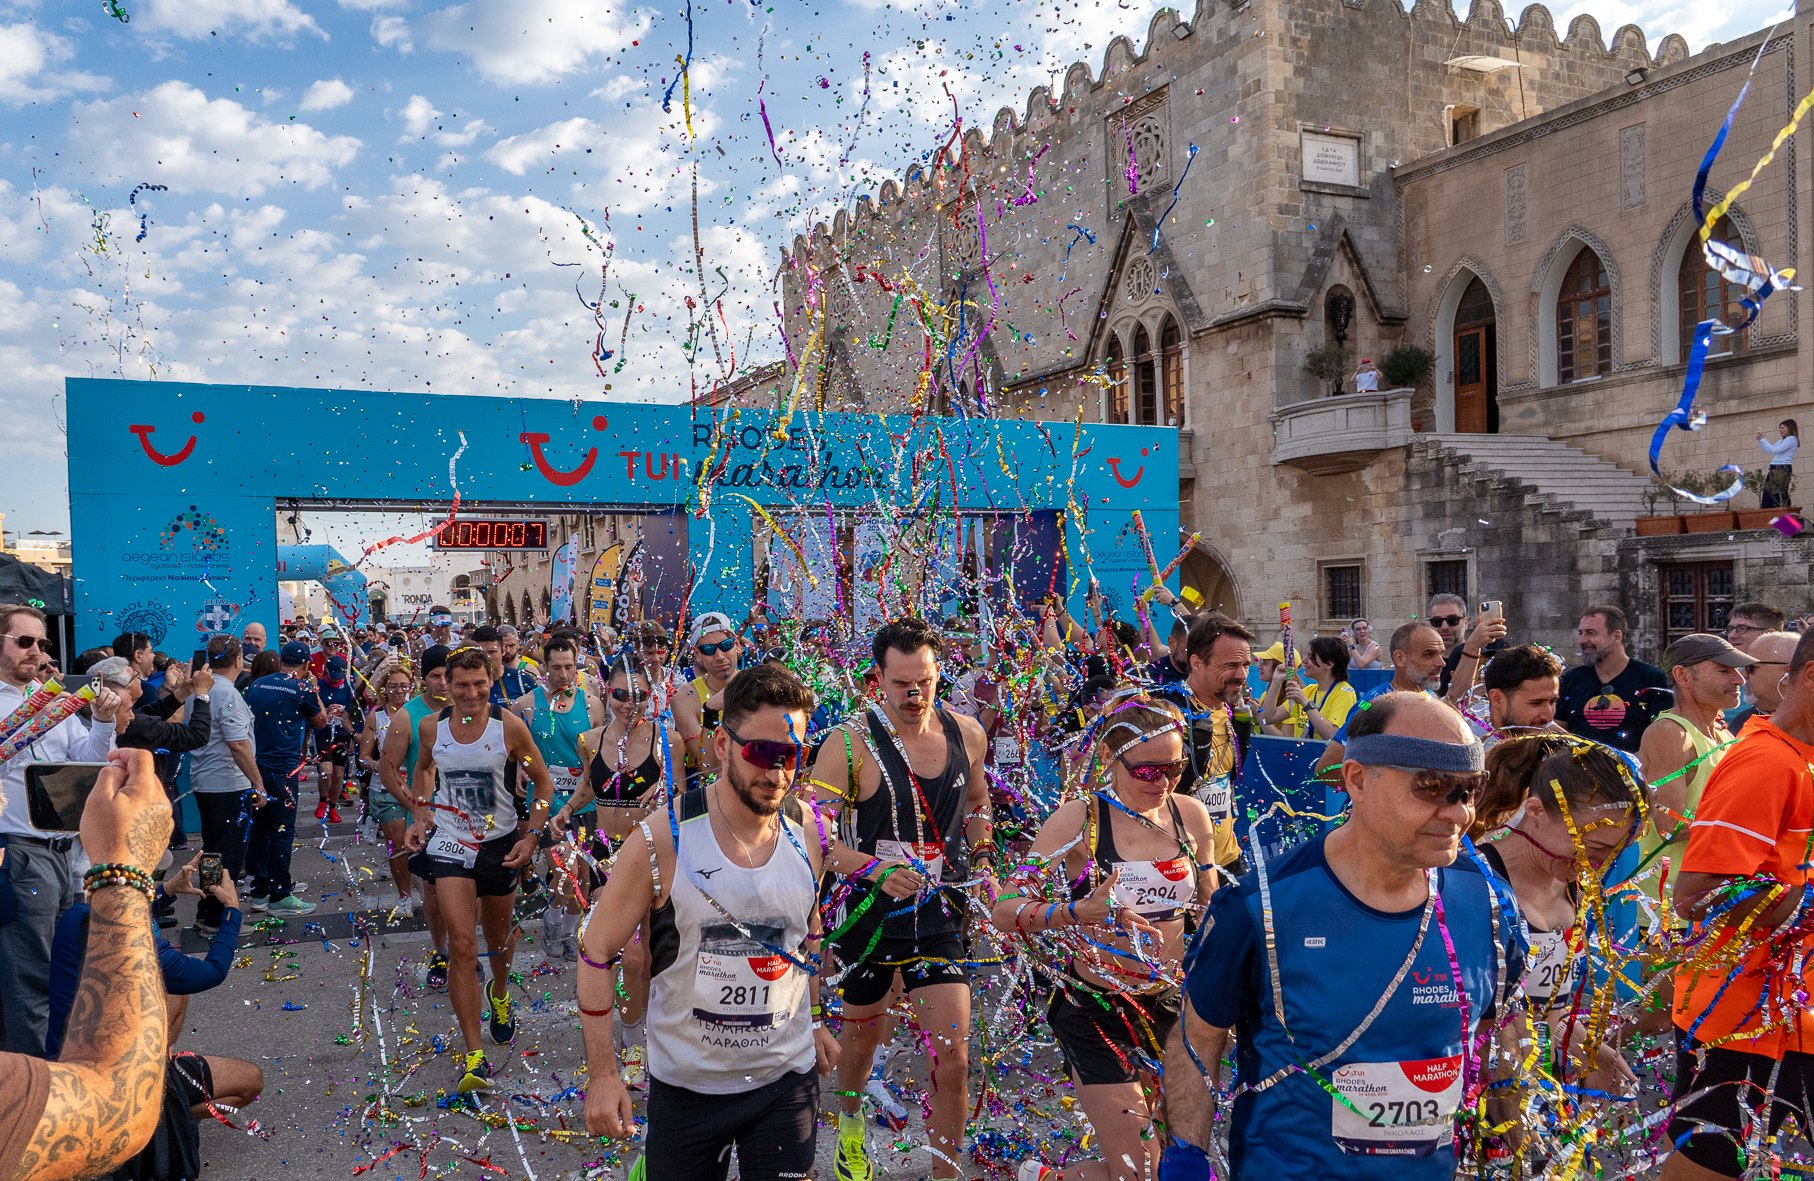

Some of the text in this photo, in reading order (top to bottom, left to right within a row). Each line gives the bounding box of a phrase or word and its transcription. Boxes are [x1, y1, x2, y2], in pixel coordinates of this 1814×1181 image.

[619, 451, 679, 481] TUI
[439, 522, 543, 547] 00:00:07
[121, 552, 178, 565] aegean
[403, 594, 433, 605] RONDA
[114, 600, 177, 629] ΔΗΜΟΣ ΡΟΔΟΥ
[556, 777, 577, 786] 2794
[1205, 792, 1227, 807] 4007
[438, 841, 465, 855] 2806
[1118, 875, 1148, 883] arathon
[756, 962, 789, 973] MARATHON
[767, 959, 782, 967] HALF
[698, 969, 737, 979] marathon
[1434, 973, 1448, 982] TUI
[719, 985, 770, 1006] 2811
[1412, 985, 1450, 995] RHODES
[1412, 990, 1473, 1005] marathn
[1427, 1062, 1448, 1073] HALF
[1413, 1068, 1459, 1082] MARATHON
[1335, 1078, 1367, 1086] RHODES
[1336, 1083, 1388, 1093] marathon
[1368, 1099, 1439, 1128] 2703
